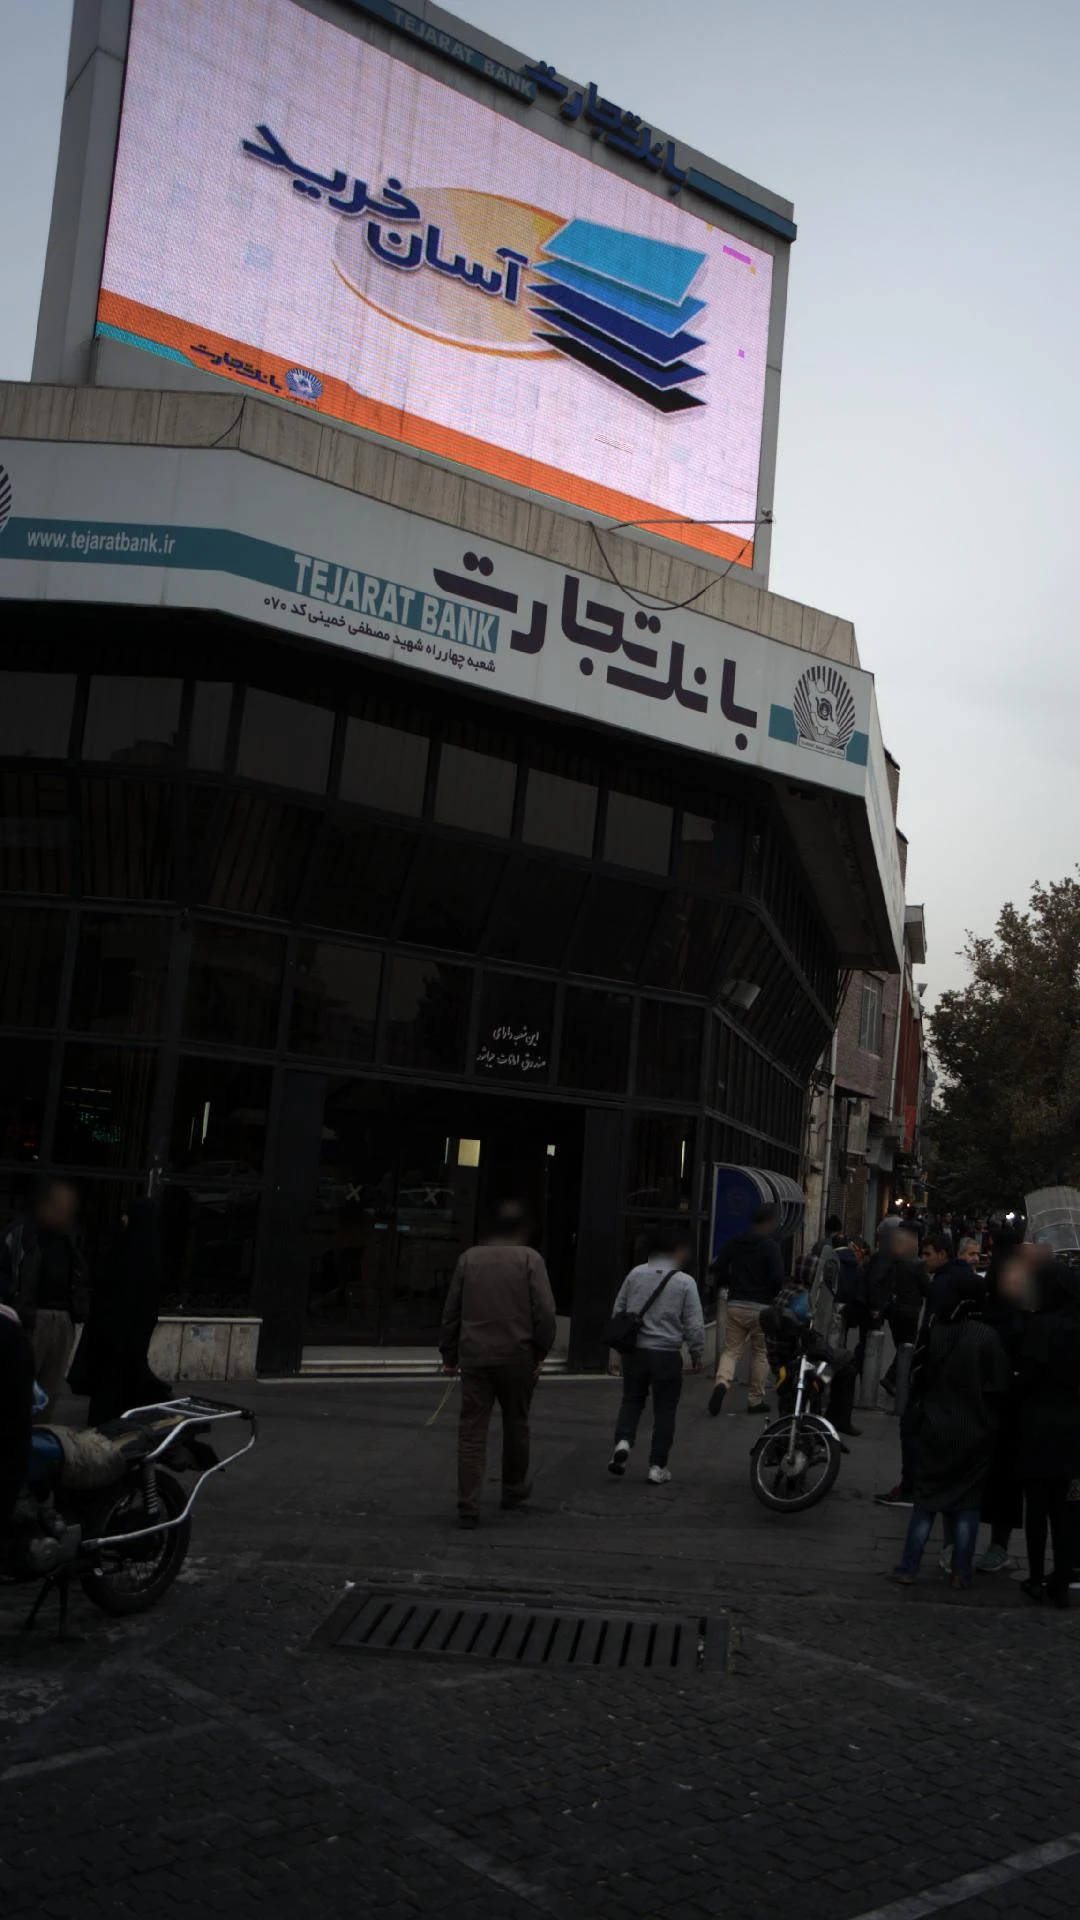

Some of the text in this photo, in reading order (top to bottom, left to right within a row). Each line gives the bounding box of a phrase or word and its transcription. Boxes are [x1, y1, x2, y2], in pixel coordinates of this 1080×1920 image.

[393, 10, 534, 100] TEJARAT BANK
[524, 60, 687, 197] بانک تجارت
[242, 124, 421, 220] خرید
[366, 221, 528, 303] آسان
[190, 344, 283, 393] بانک تجارت
[27, 529, 176, 556] www.tejaratbank.ir
[263, 596, 287, 611] ۰۷۰
[290, 602, 307, 617] کد
[294, 553, 497, 651] TEJARAT BANK
[308, 612, 346, 628] خمینی
[348, 622, 391, 642] مصطفی
[392, 633, 424, 653] شهید
[433, 551, 758, 751] بانک تجارت
[467, 655, 496, 674] شعبه
